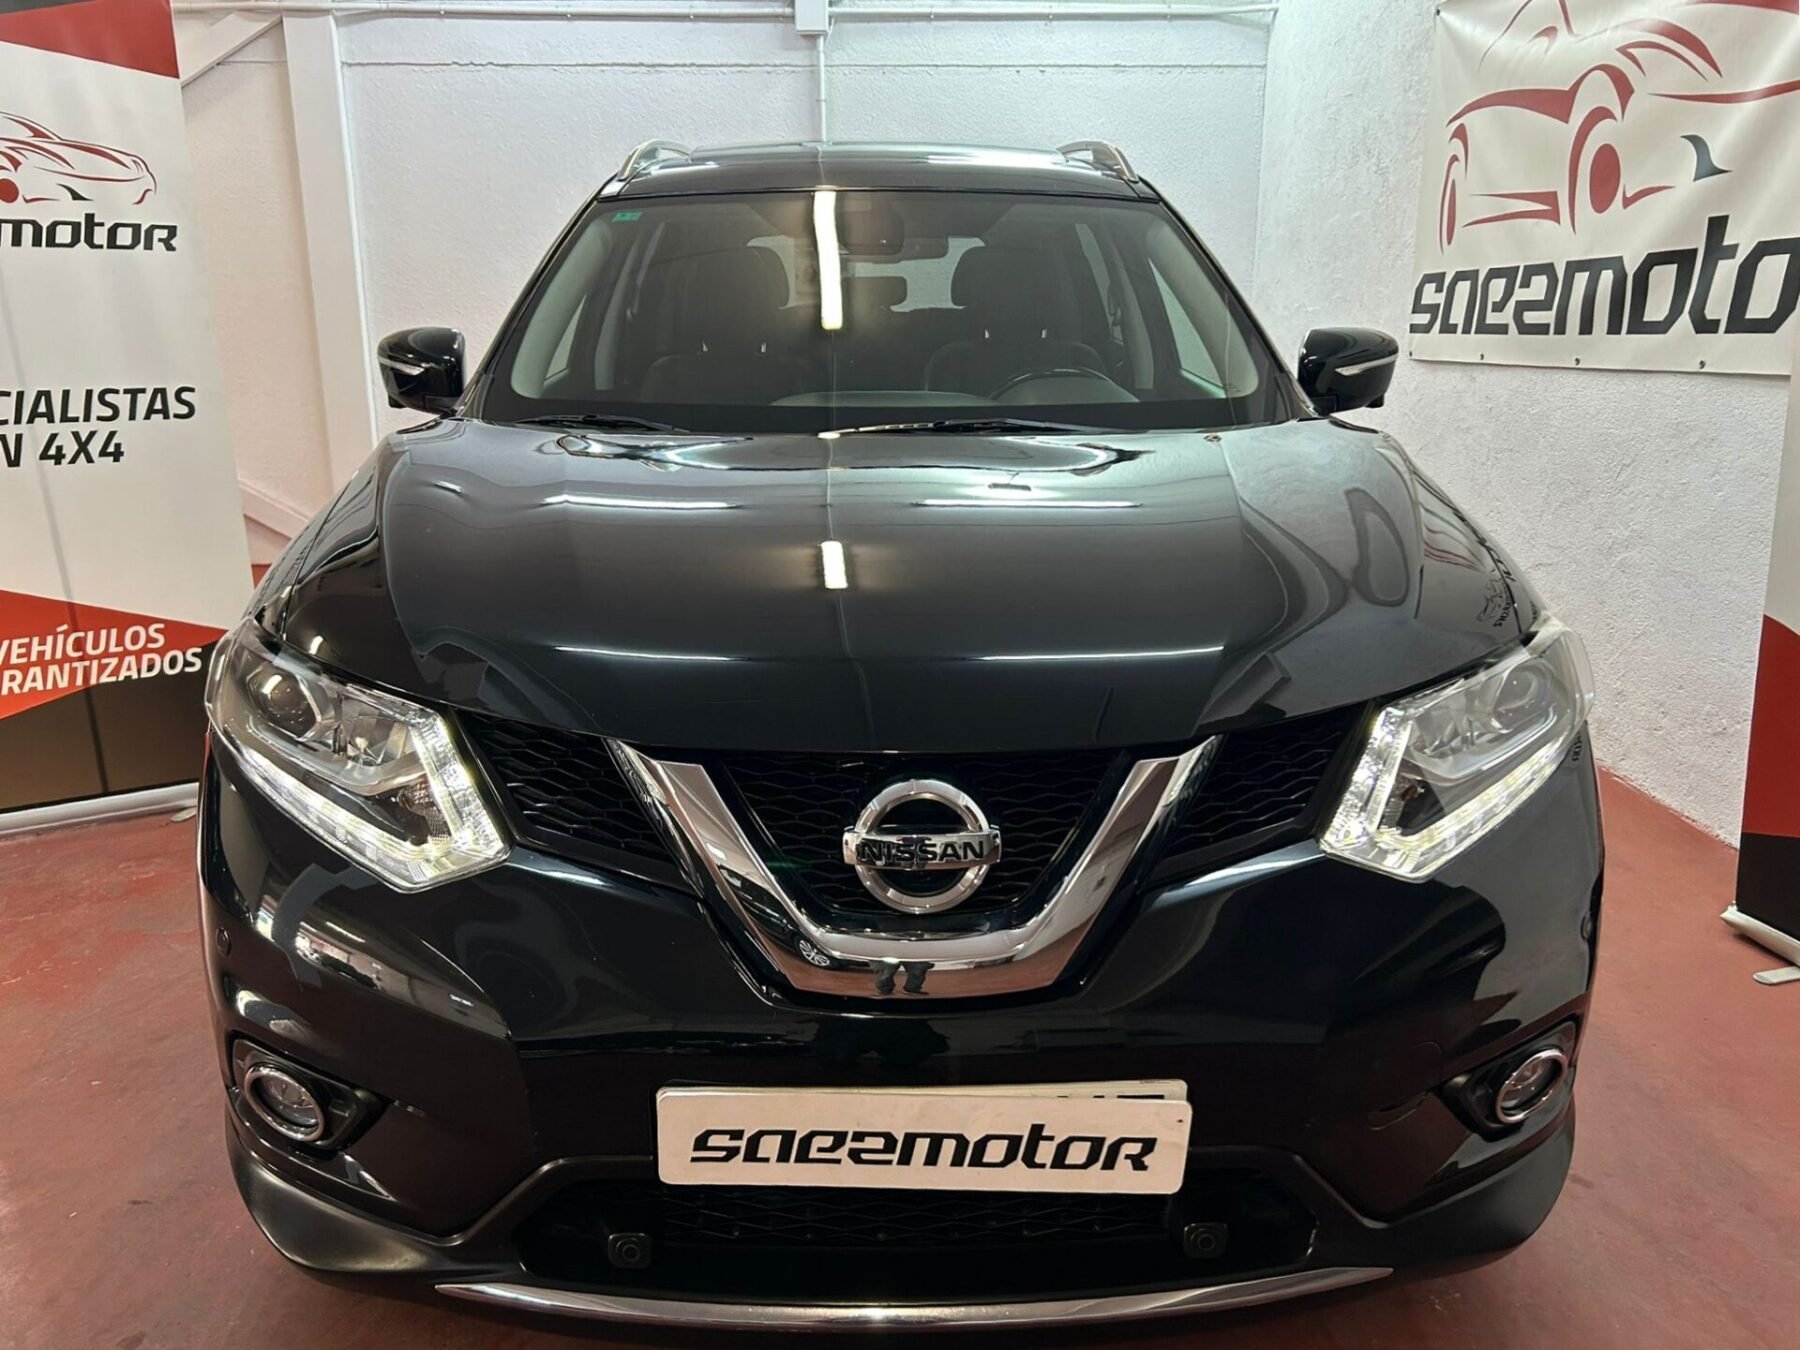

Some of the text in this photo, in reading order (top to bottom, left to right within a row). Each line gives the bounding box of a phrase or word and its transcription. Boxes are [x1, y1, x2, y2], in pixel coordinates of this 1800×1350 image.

[39, 430, 124, 466] 4X4
[1, 647, 202, 695] RANTIZADOS
[860, 839, 983, 863] NISSAN
